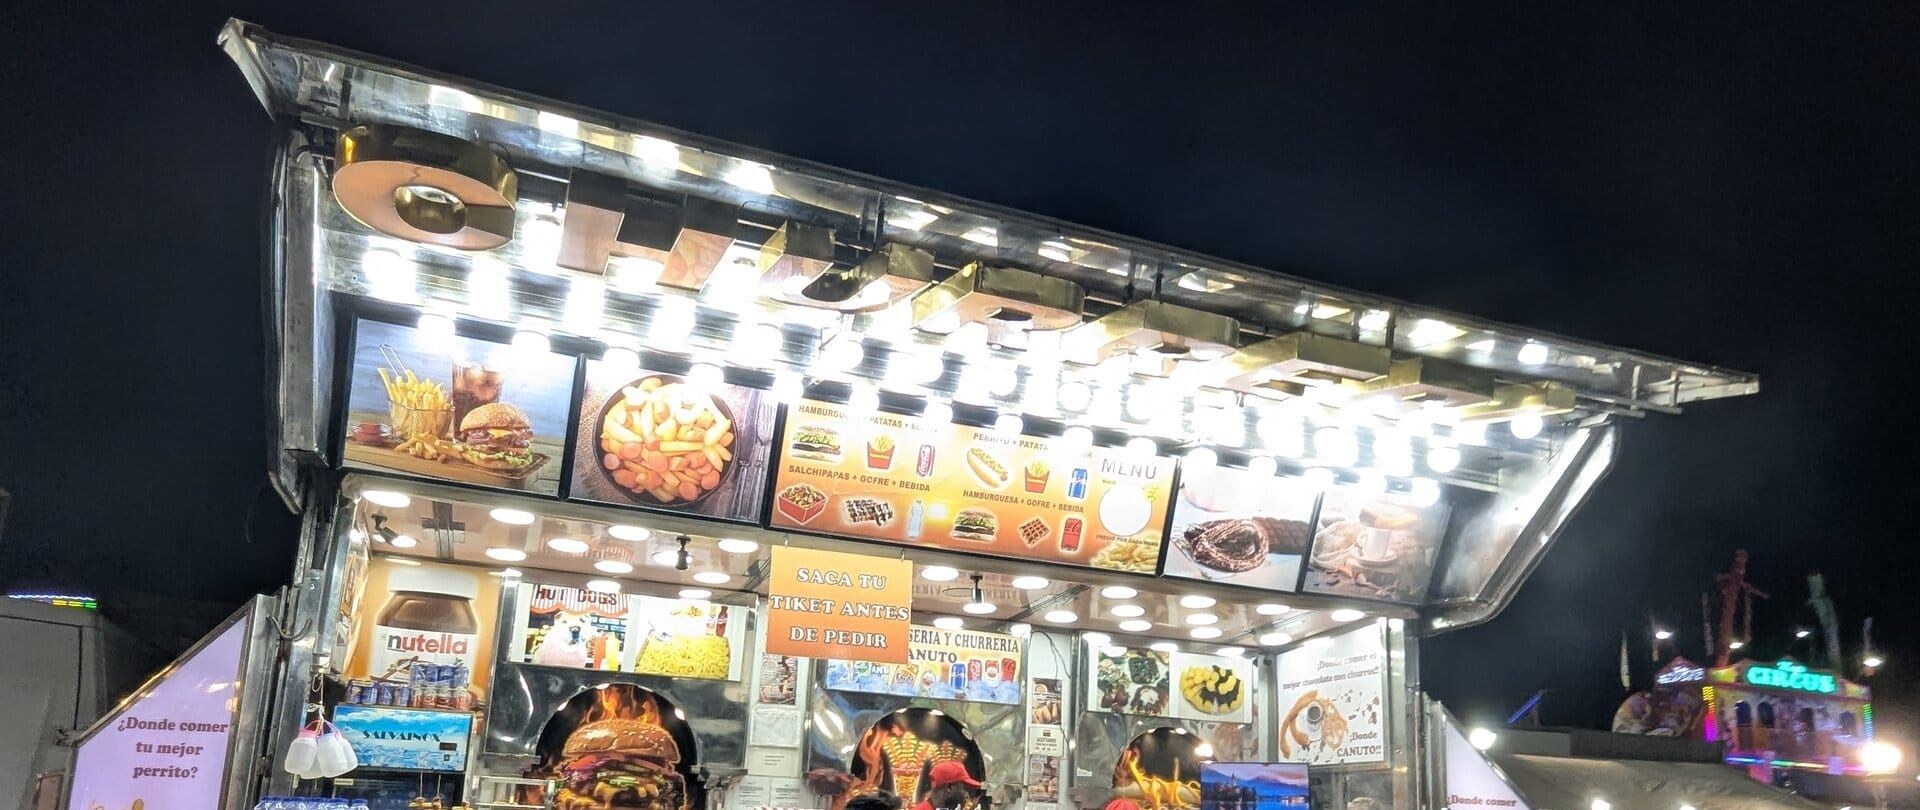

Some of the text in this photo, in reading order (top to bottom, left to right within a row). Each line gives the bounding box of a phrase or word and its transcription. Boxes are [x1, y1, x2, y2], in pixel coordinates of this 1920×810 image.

[788, 464, 850, 481] SALCHIPAPAS
[899, 480, 931, 492] BEBIDA
[962, 489, 1019, 505] HAMBURGUESA
[1026, 498, 1051, 509] GOFRE
[1058, 503, 1085, 513] BEBIDA
[796, 568, 887, 590] SACA TU
[770, 594, 910, 621] TIKET ANTES
[387, 634, 468, 654] nutella
[790, 626, 888, 649] DE PEDIR
[944, 632, 952, 646] Y
[954, 633, 1019, 653] CHURRERIA
[1746, 666, 1836, 693] CIRCUS
[117, 715, 229, 733] ¿Donde comer
[136, 740, 204, 758] tu mejor
[132, 765, 198, 780] perrito?
[1485, 798, 1517, 807] comer
